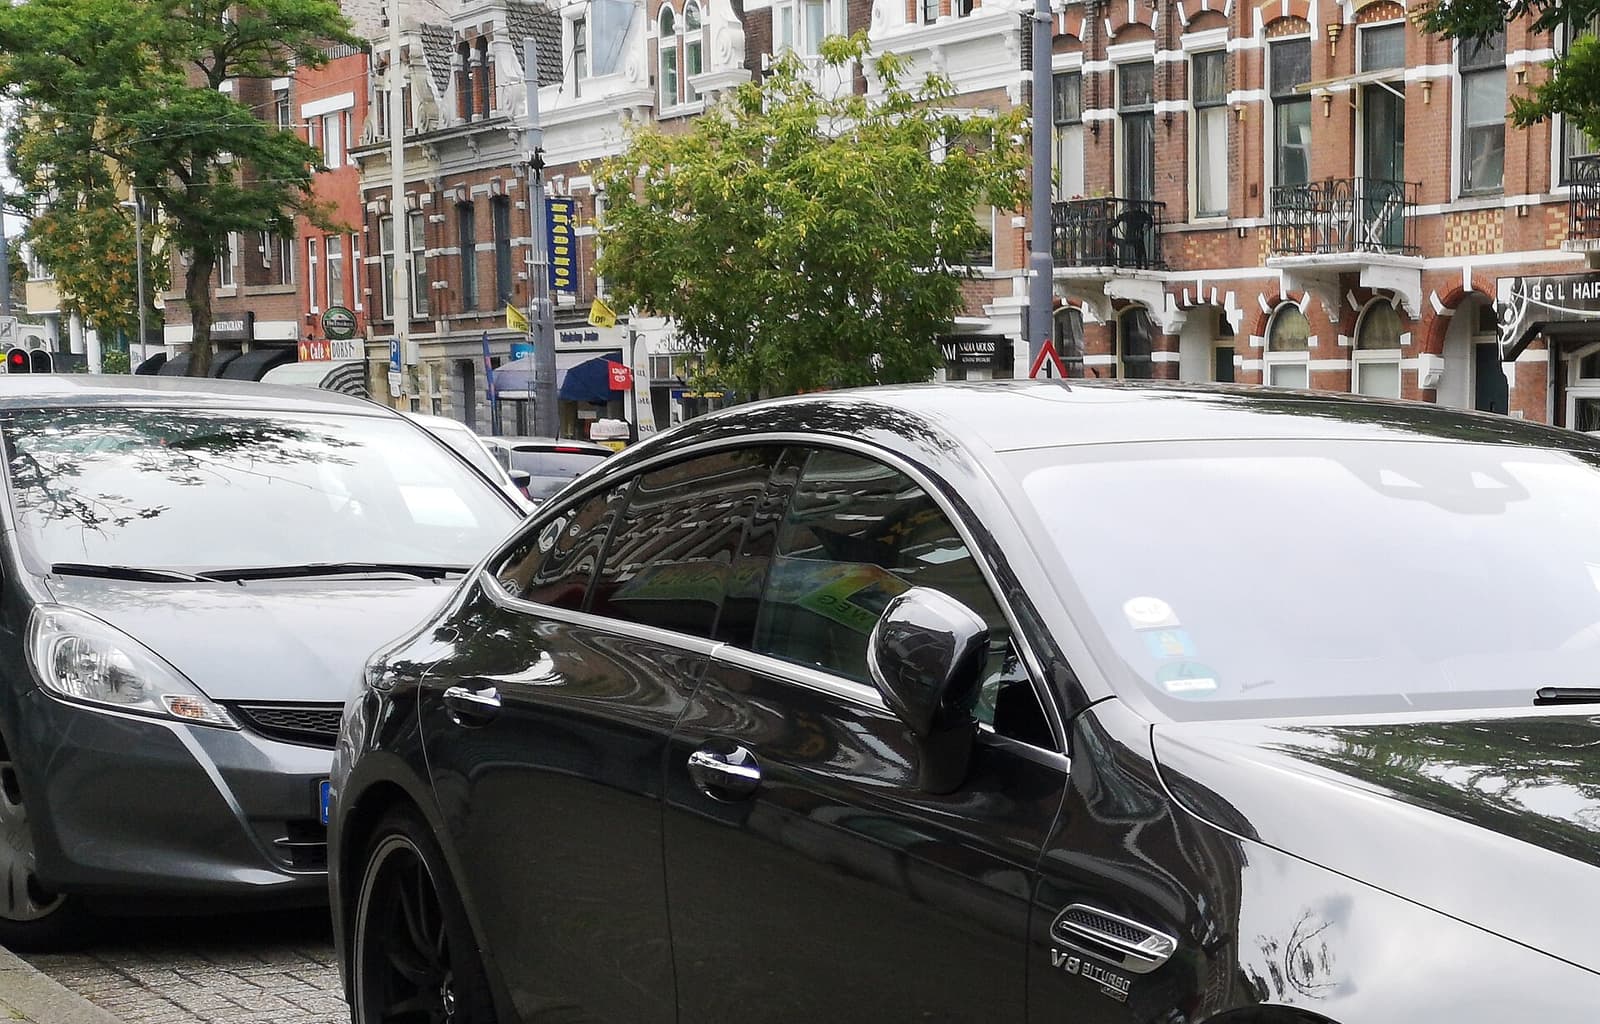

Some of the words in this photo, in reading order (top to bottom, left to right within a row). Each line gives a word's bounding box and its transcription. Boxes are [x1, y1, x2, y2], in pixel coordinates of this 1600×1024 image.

[1532, 284, 1542, 300] G
[1545, 283, 1554, 300] &
[1557, 283, 1566, 300] L
[310, 342, 325, 360] Café
[1050, 948, 1081, 975] V8
[1082, 962, 1131, 991] BITURBO
